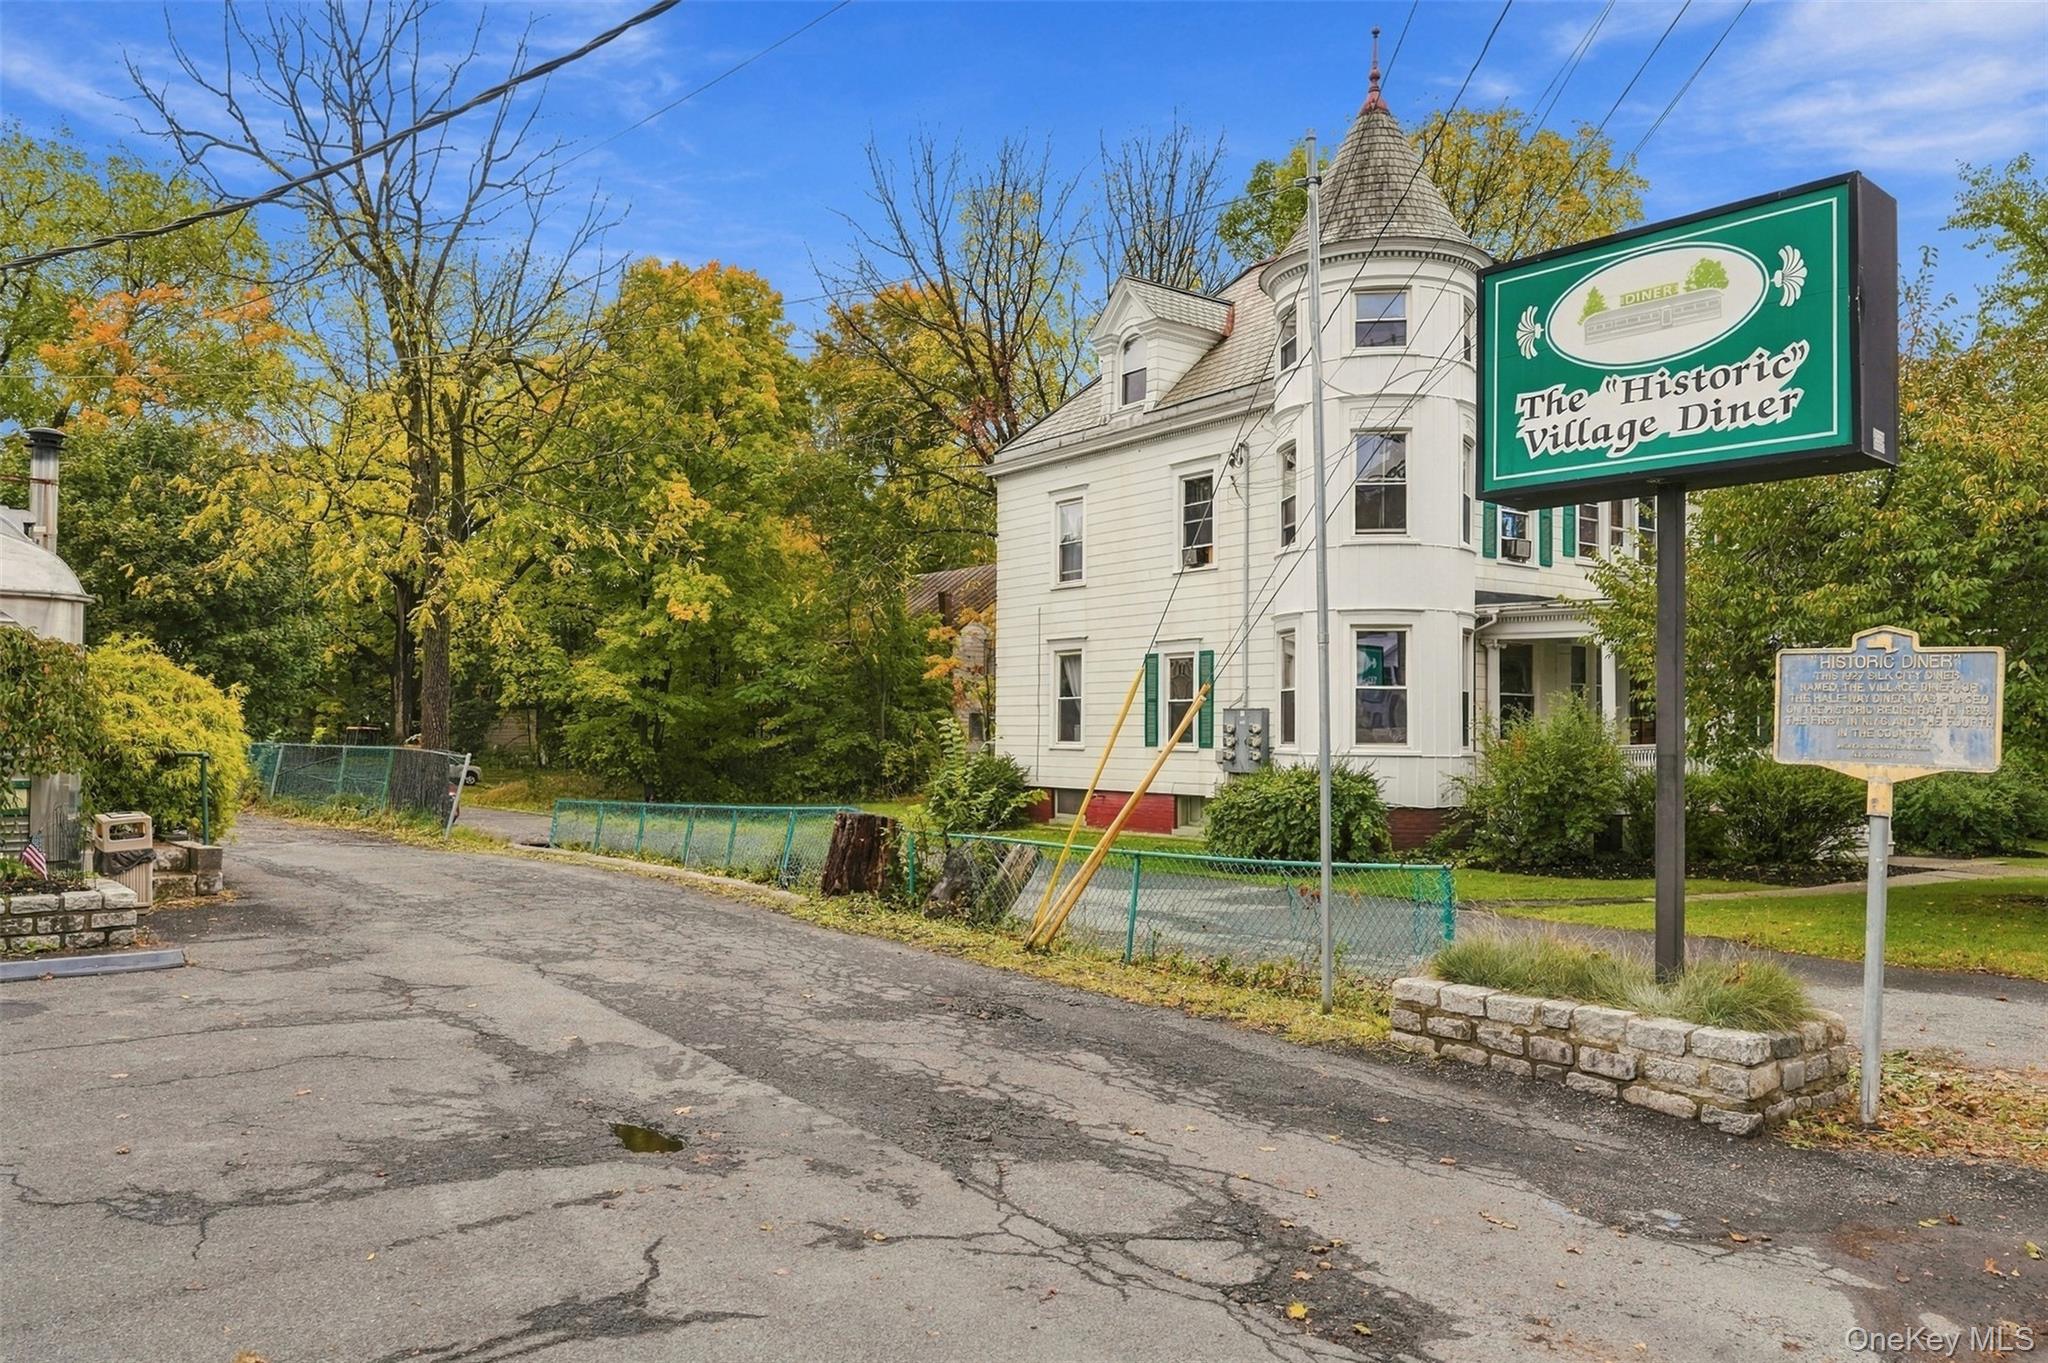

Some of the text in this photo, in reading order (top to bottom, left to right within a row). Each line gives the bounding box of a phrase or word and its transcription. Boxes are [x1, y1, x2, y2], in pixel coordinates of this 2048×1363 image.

[1625, 285, 1672, 304] DINER
[1520, 344, 1806, 421] The "Historic"
[1525, 389, 1799, 453] Village Diner
[1902, 654, 1960, 669] DINER"
[1814, 671, 1838, 680] THIS
[1867, 671, 1893, 680] SILK
[1896, 671, 1920, 680] CITY
[1843, 682, 1864, 691] THE
[1869, 682, 1917, 692] VILLAGE
[1789, 693, 1808, 703] THE
[1811, 716, 1841, 725] FIRST
[1852, 728, 1874, 738] THE
